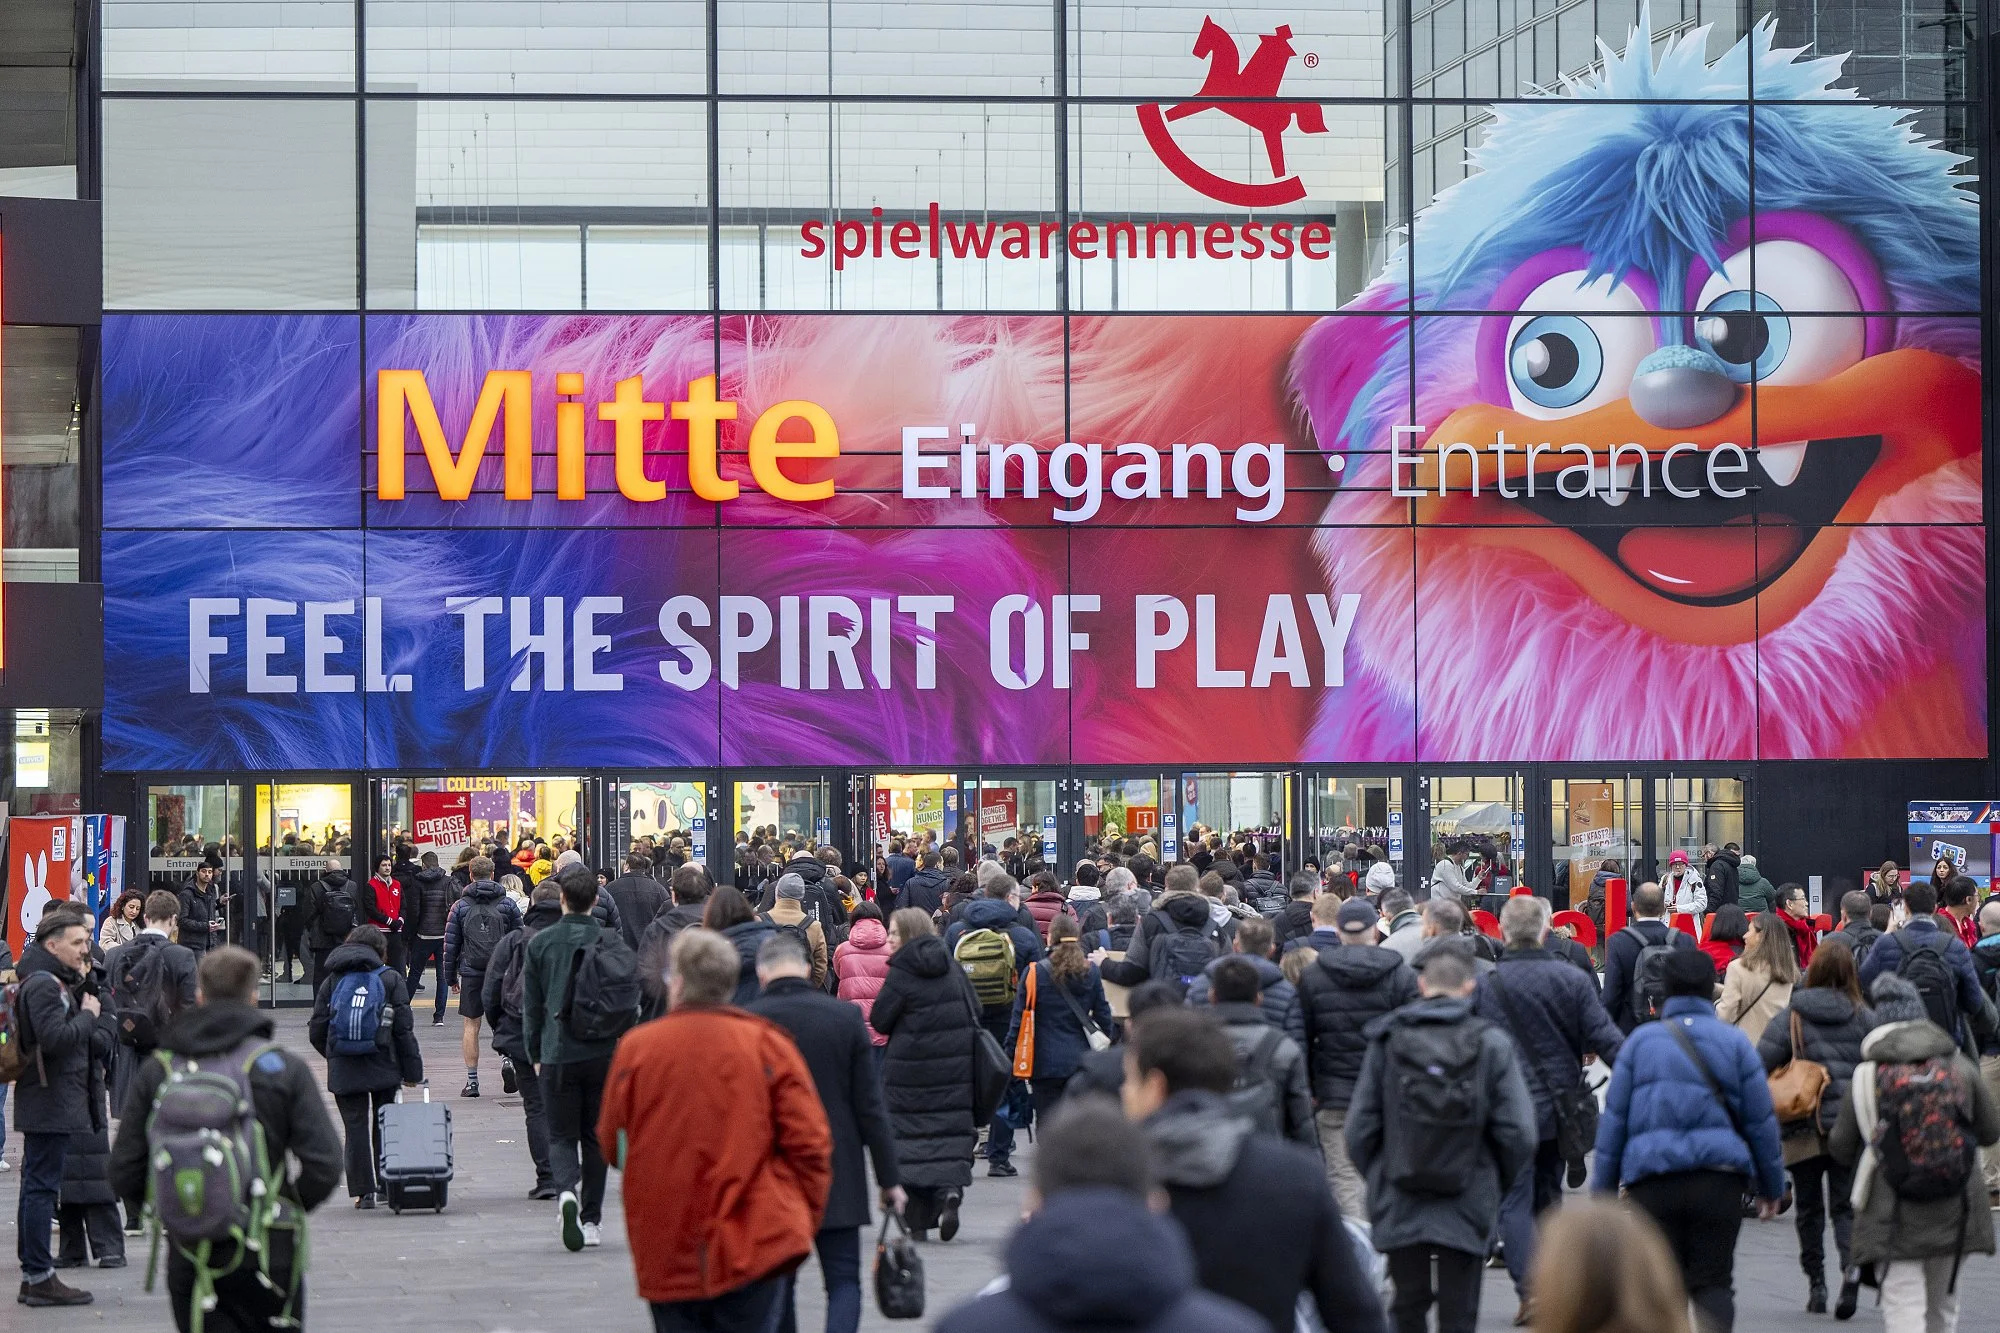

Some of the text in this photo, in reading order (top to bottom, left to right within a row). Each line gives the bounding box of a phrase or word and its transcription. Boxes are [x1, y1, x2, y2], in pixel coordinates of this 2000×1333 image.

[800, 202, 1331, 271] spielwarenmesse
[378, 369, 840, 502] Mitte
[901, 423, 1286, 523] Eingang
[1389, 425, 1749, 499] Entrance
[189, 593, 1362, 693] FEEL THE SPIRIT OF PLAY
[447, 777, 532, 792] COLLECTIBES
[418, 816, 465, 835] PLEASE
[916, 810, 943, 824] HUNGR
[434, 830, 467, 847] NOTE
[166, 859, 201, 868] Entran
[289, 858, 328, 869] Eingang
